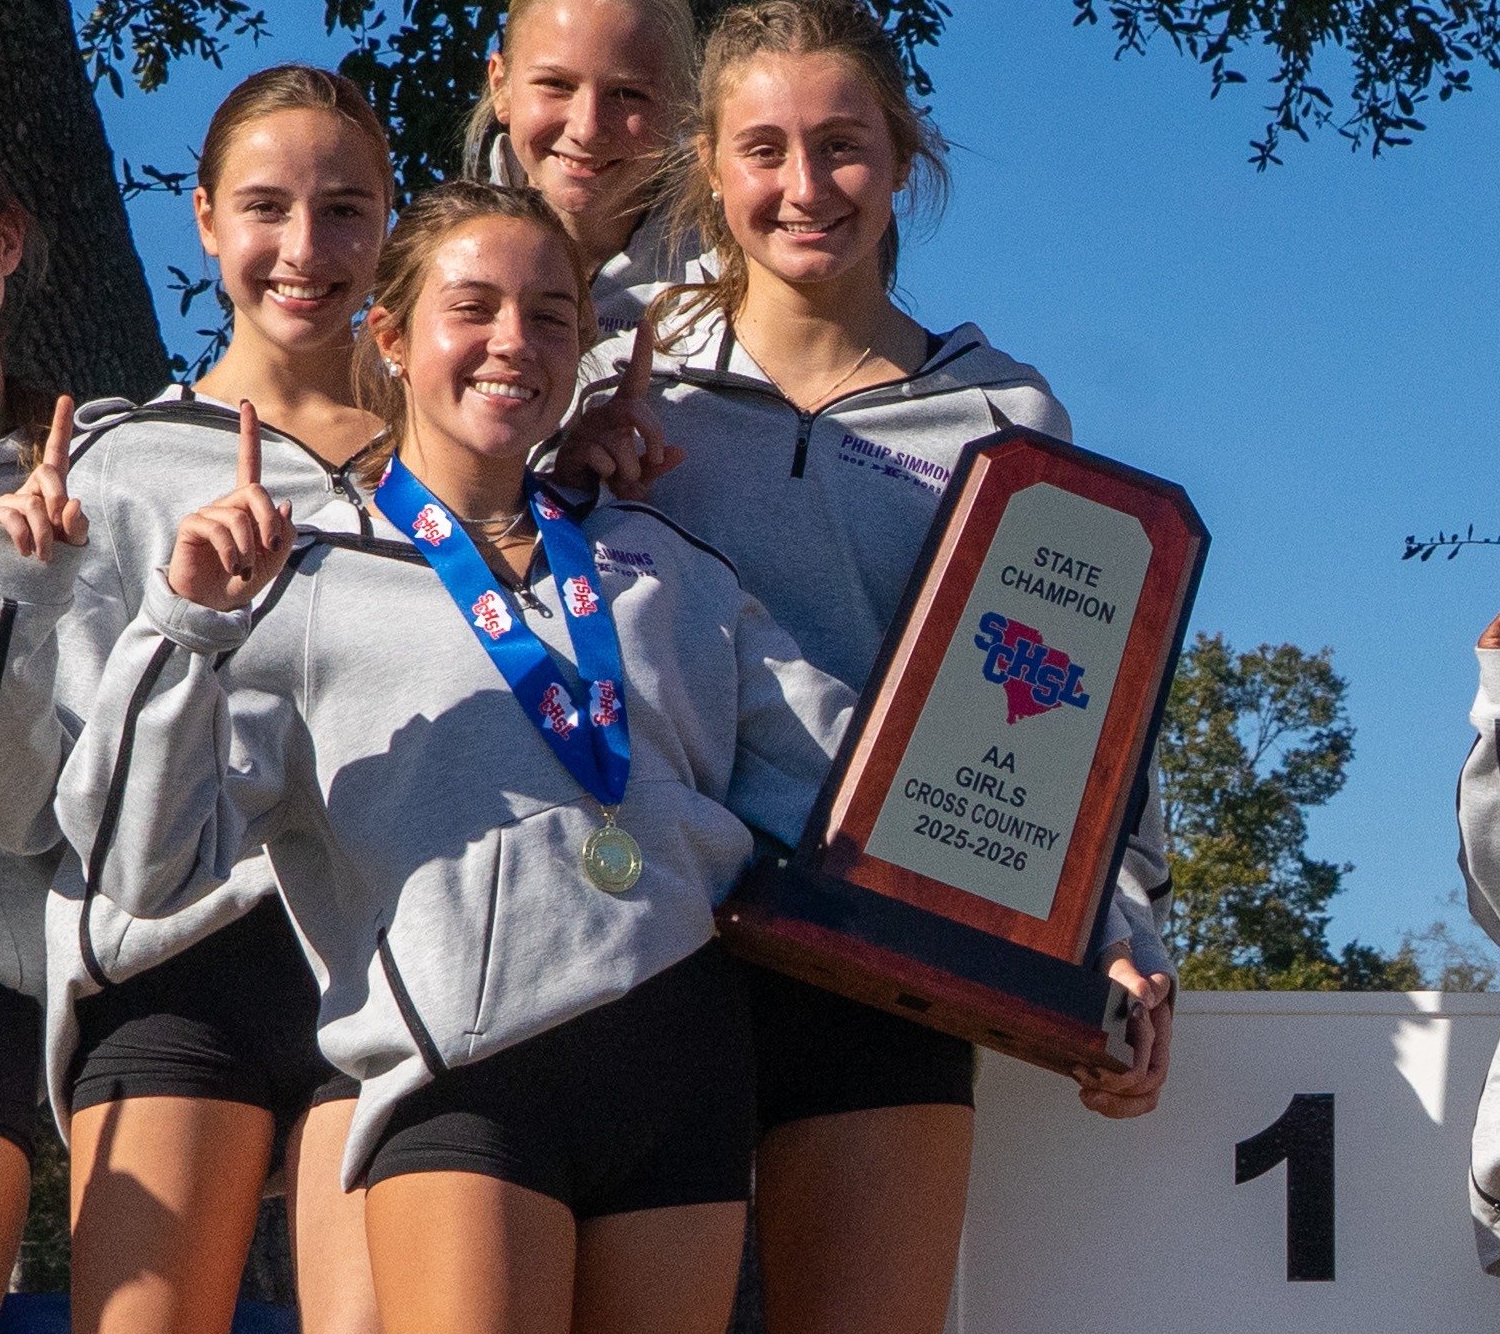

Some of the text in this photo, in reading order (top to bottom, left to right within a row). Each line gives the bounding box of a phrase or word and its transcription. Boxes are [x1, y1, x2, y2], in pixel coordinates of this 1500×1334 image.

[838, 453, 865, 466] IRON
[913, 478, 942, 494] HORS
[841, 434, 952, 483] PHILIP SIMMON
[1034, 547, 1103, 588] STATE
[1001, 565, 1117, 624] CHAMPION
[974, 611, 1090, 710] SCHSL
[981, 745, 1015, 774] AA
[956, 766, 1027, 807] GIRLS
[904, 778, 1060, 851] CROSS COUNTRY
[914, 814, 1029, 871] 2025-2026
[1235, 1093, 1336, 1282] 1
